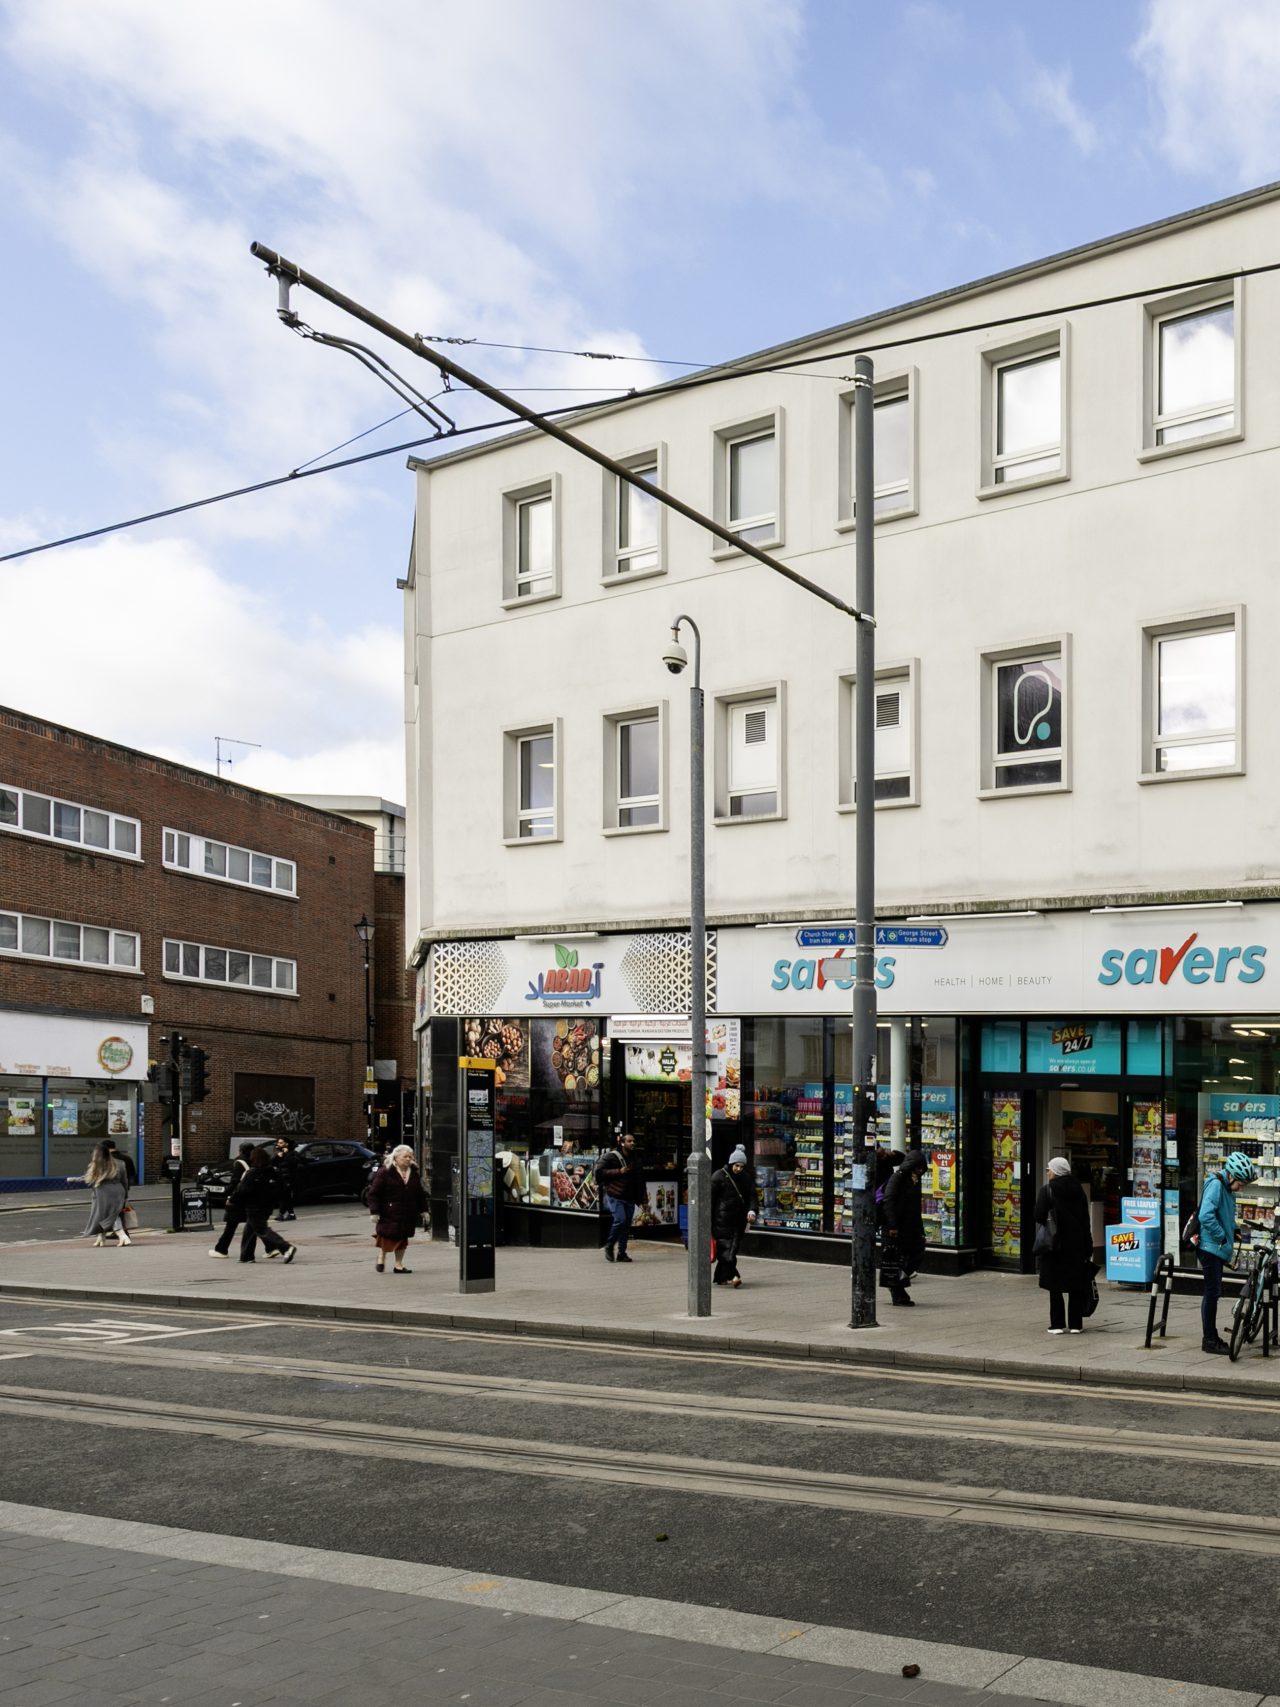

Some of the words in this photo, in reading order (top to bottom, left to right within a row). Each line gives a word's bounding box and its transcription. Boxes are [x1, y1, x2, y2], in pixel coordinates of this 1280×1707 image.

[1097, 931, 1267, 985] savers
[544, 968, 592, 993] ABAD
[934, 977, 966, 986] HEALTH
[979, 976, 1004, 986] HOME
[1017, 976, 1053, 985] BEAUTY
[1054, 1024, 1085, 1042] SAVE
[1064, 1035, 1091, 1053] 24/7
[1223, 1100, 1267, 1113] savers
[1111, 1232, 1134, 1244] SAVE
[1119, 1240, 1139, 1252] 24/7
